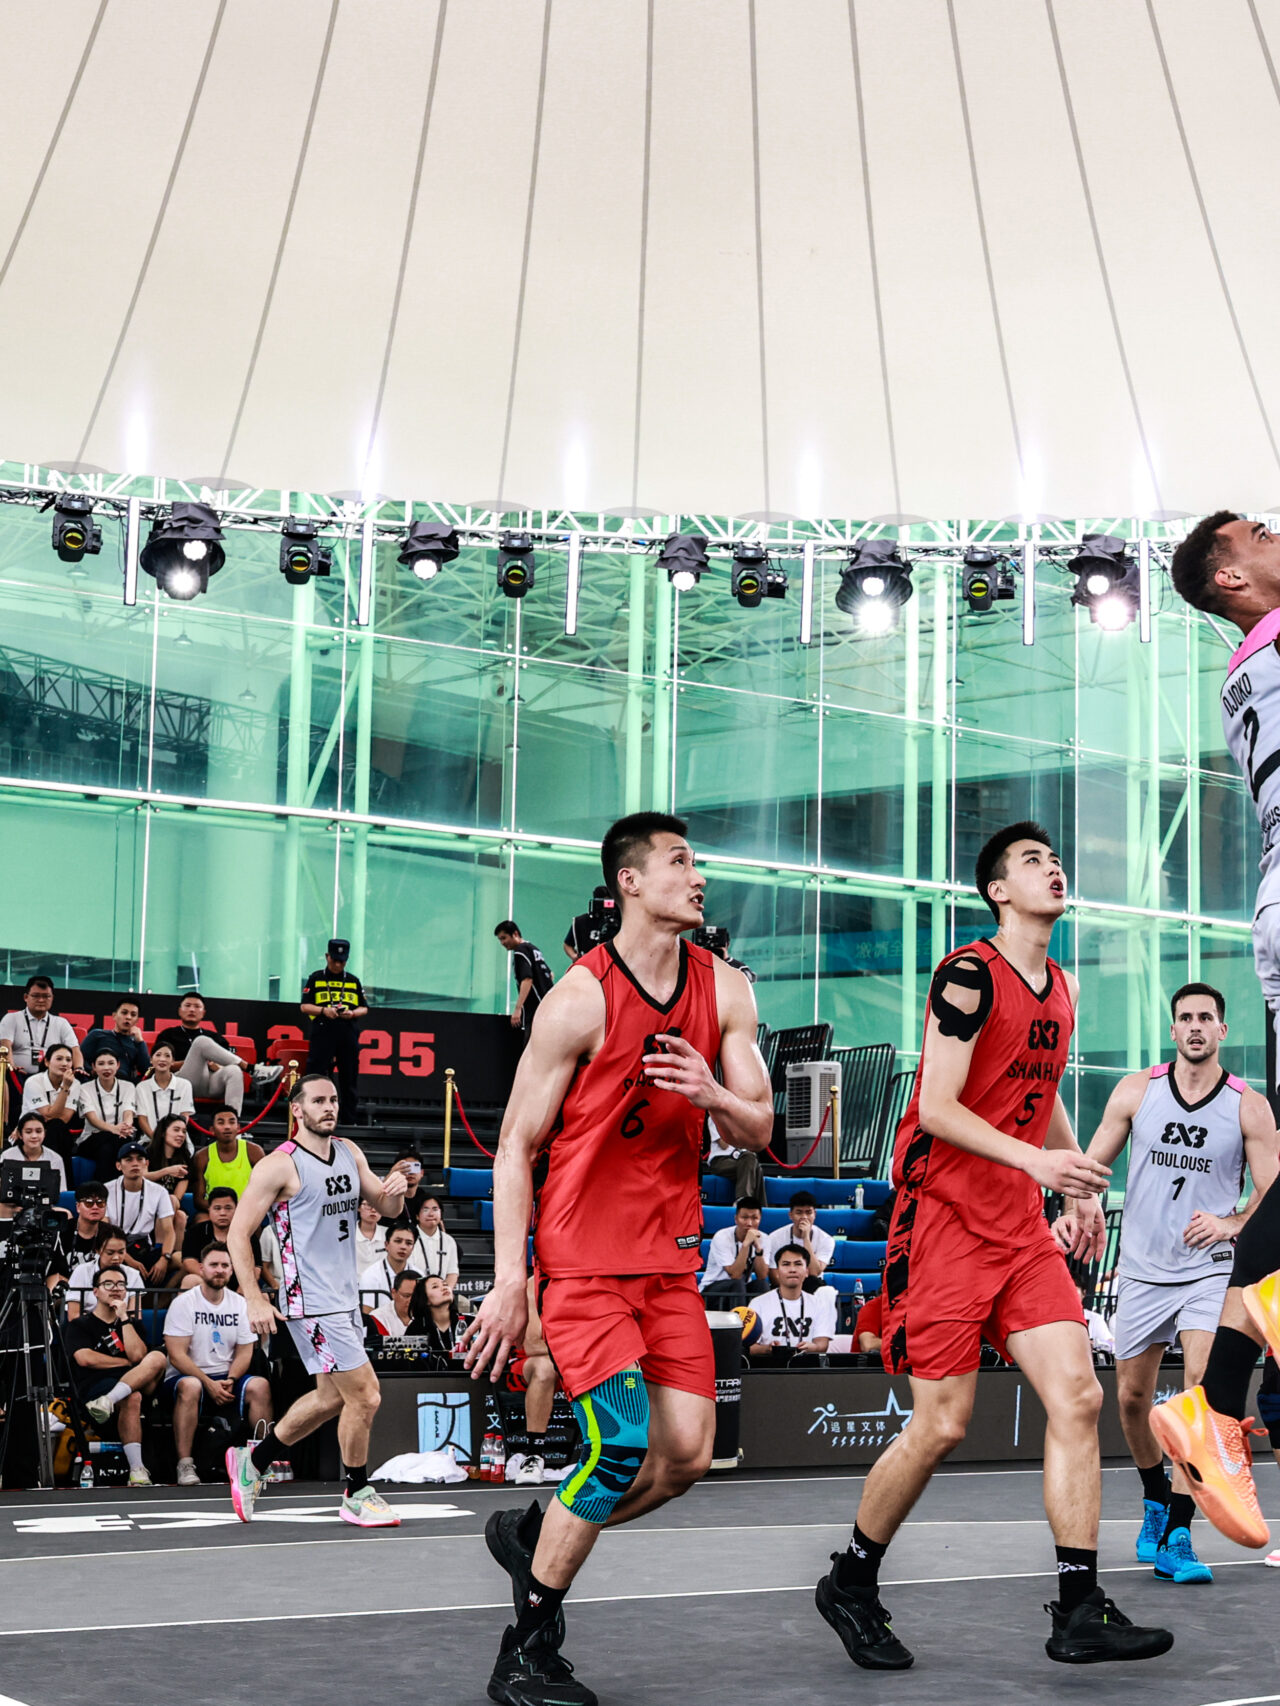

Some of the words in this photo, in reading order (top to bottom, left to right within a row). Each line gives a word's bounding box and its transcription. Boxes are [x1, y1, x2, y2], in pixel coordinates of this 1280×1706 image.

[1221, 672, 1252, 719] DJOKO
[621, 1098, 651, 1139] 6
[1015, 1092, 1043, 1127] 5
[1160, 1121, 1209, 1149] 3X3
[1151, 1150, 1213, 1174] TOULOUSE
[325, 1174, 353, 1197] 3X3
[1171, 1175, 1186, 1201] 1
[194, 1311, 239, 1327] FRANCE
[830, 1420, 886, 1433] 追星文体
